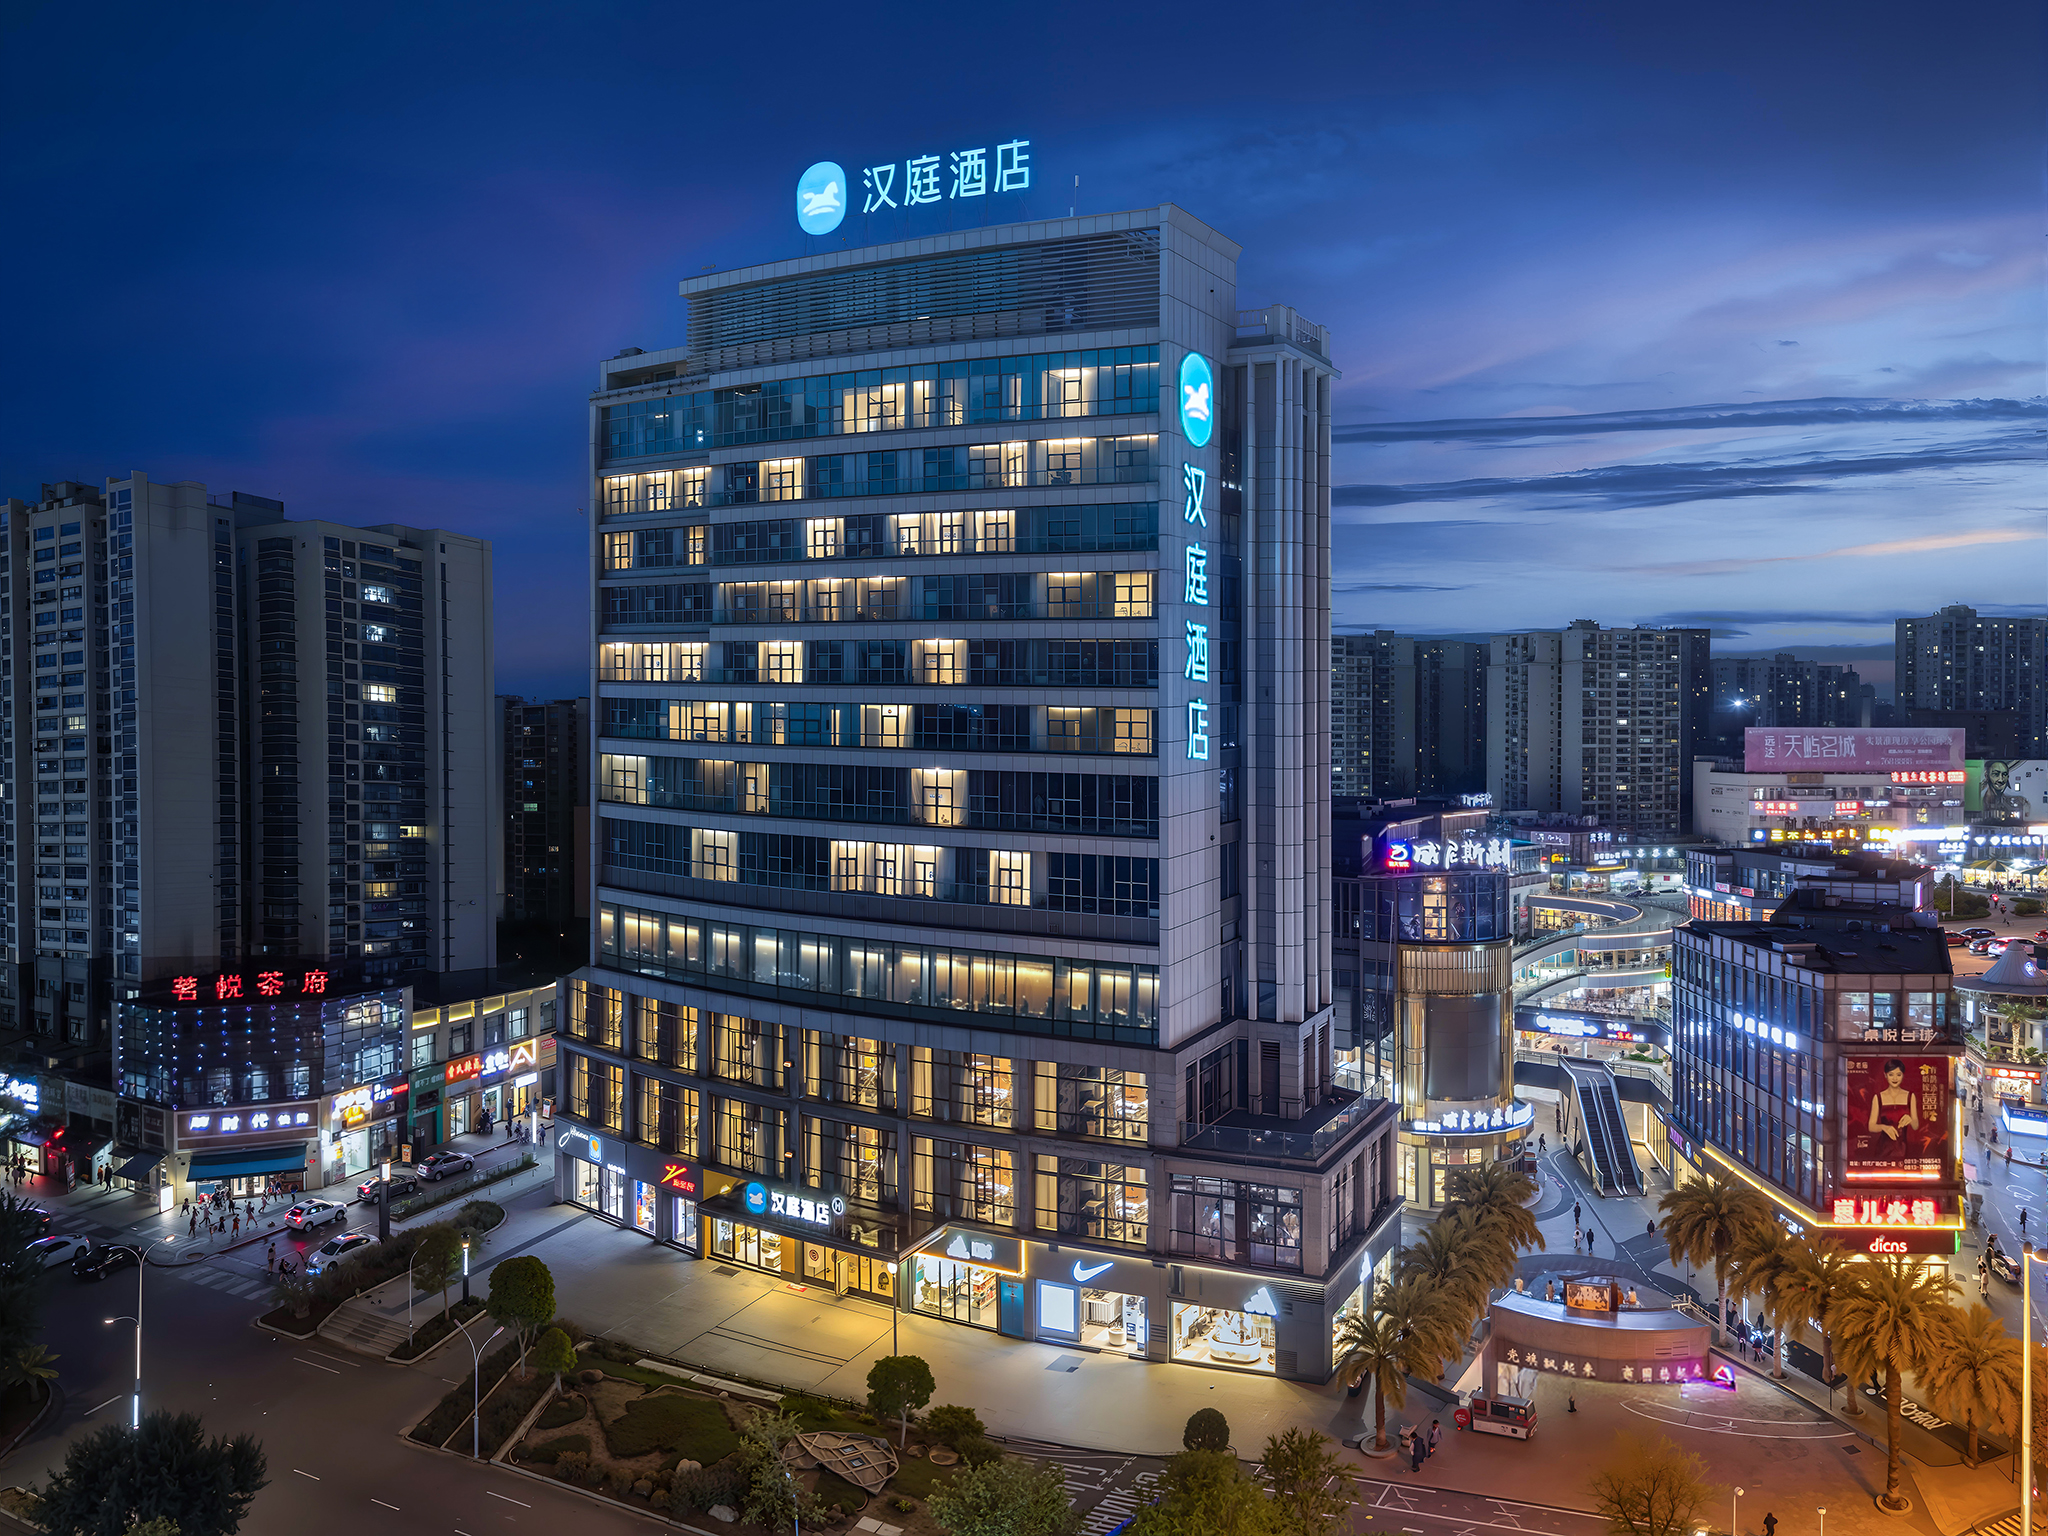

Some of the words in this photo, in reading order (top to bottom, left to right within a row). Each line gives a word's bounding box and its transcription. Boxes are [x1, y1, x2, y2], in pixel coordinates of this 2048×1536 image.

[862, 139, 1030, 214] 汉庭酒店
[1183, 462, 1209, 761] 汉庭酒店
[1784, 734, 1857, 758] 天屿名城
[171, 968, 329, 1001] 茗悦茶府
[771, 1190, 830, 1226] 汉庭酒店
